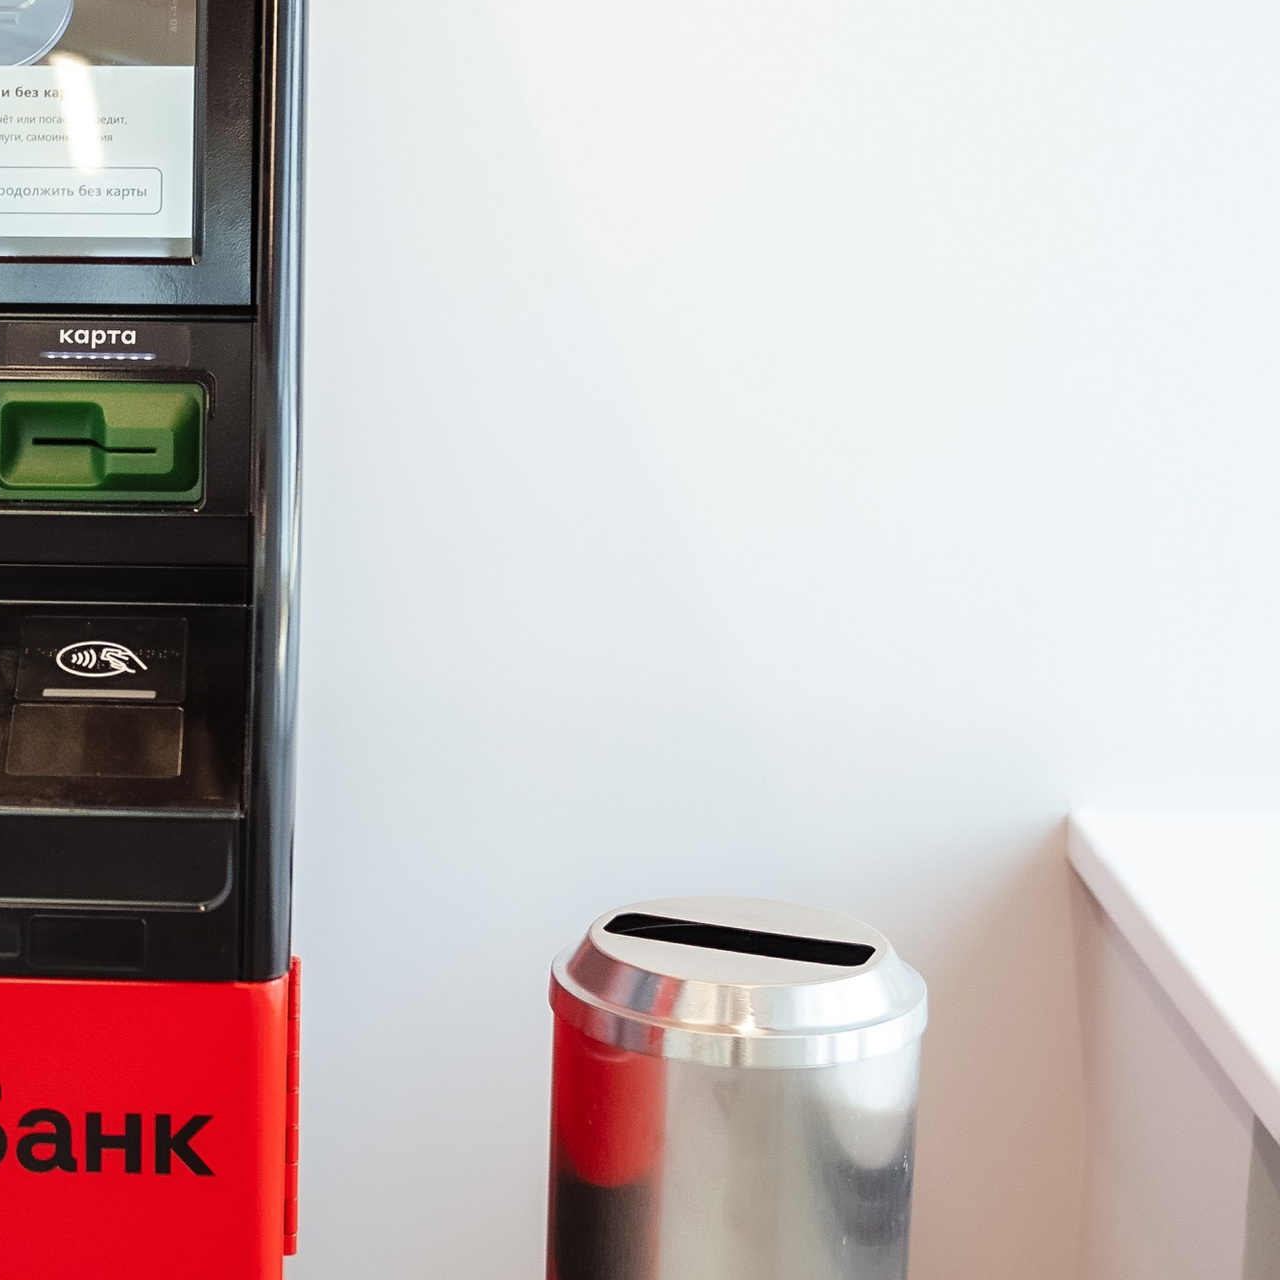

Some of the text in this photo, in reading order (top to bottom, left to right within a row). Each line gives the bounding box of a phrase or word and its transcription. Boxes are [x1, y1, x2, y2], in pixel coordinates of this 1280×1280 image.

[15, 86, 39, 98] без
[16, 116, 36, 124] или
[78, 185, 102, 197] без
[106, 187, 148, 200] карты
[59, 329, 137, 349] карта
